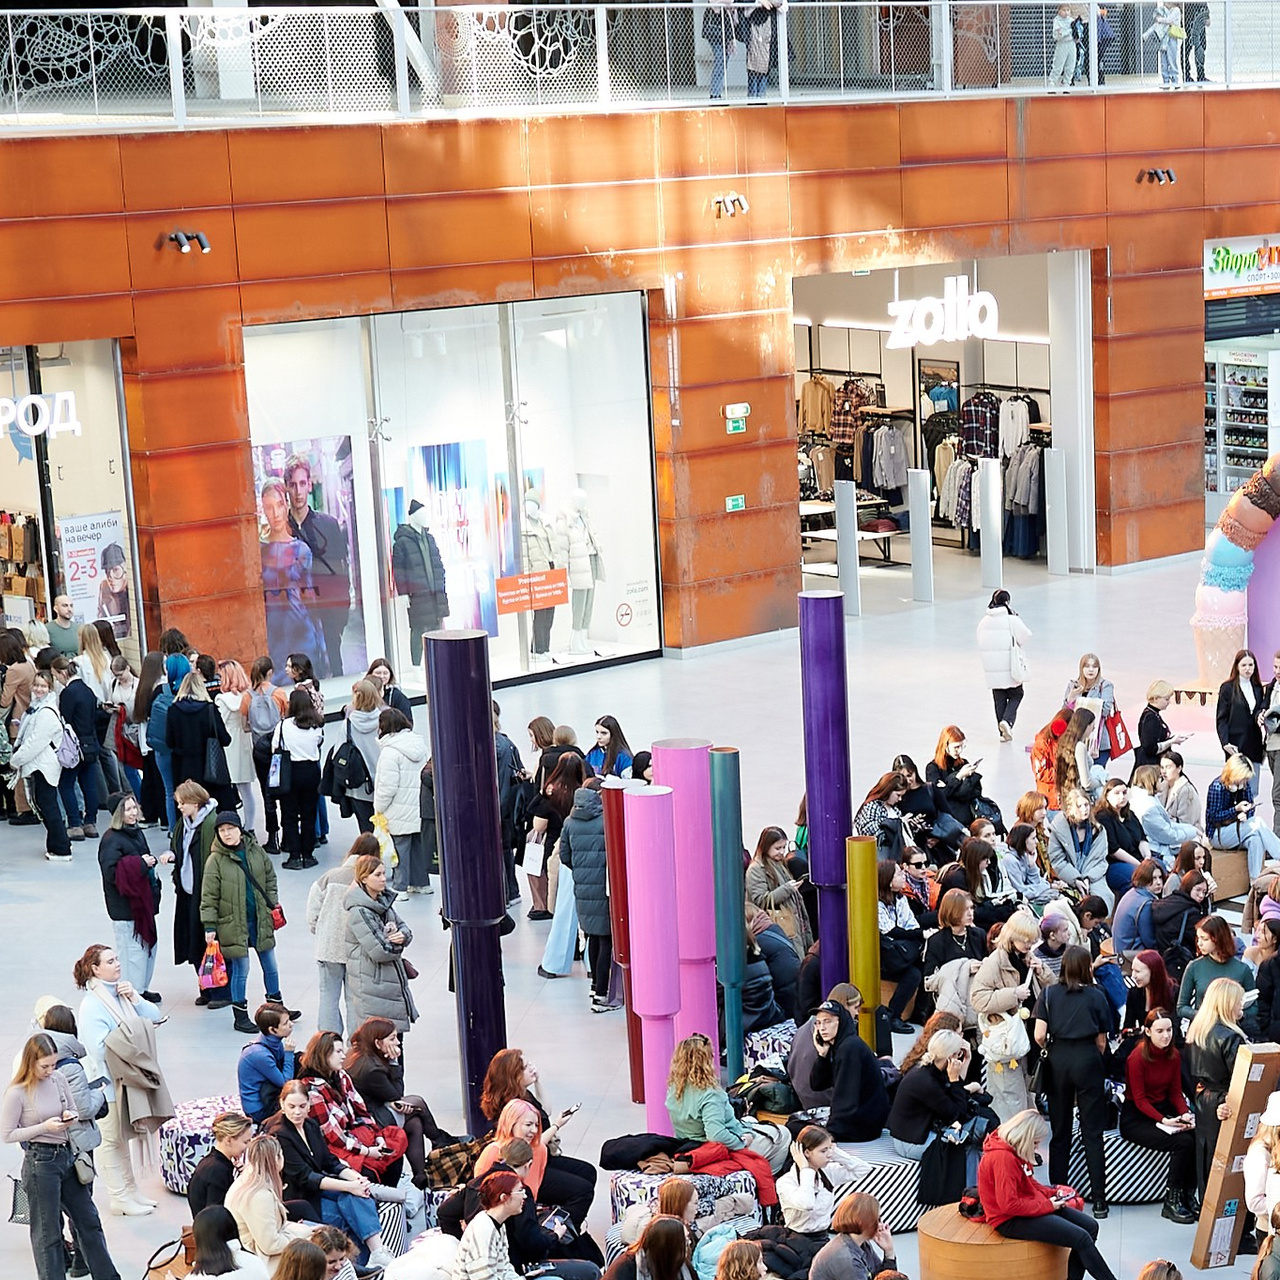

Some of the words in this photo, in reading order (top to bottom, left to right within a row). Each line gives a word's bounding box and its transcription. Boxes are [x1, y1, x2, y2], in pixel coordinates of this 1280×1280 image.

[885, 275, 999, 350] zolla
[64, 523, 88, 534] ваше
[90, 518, 118, 530] алиби
[65, 535, 76, 544] на
[78, 532, 102, 543] вечер
[69, 558, 98, 582] 2=3
